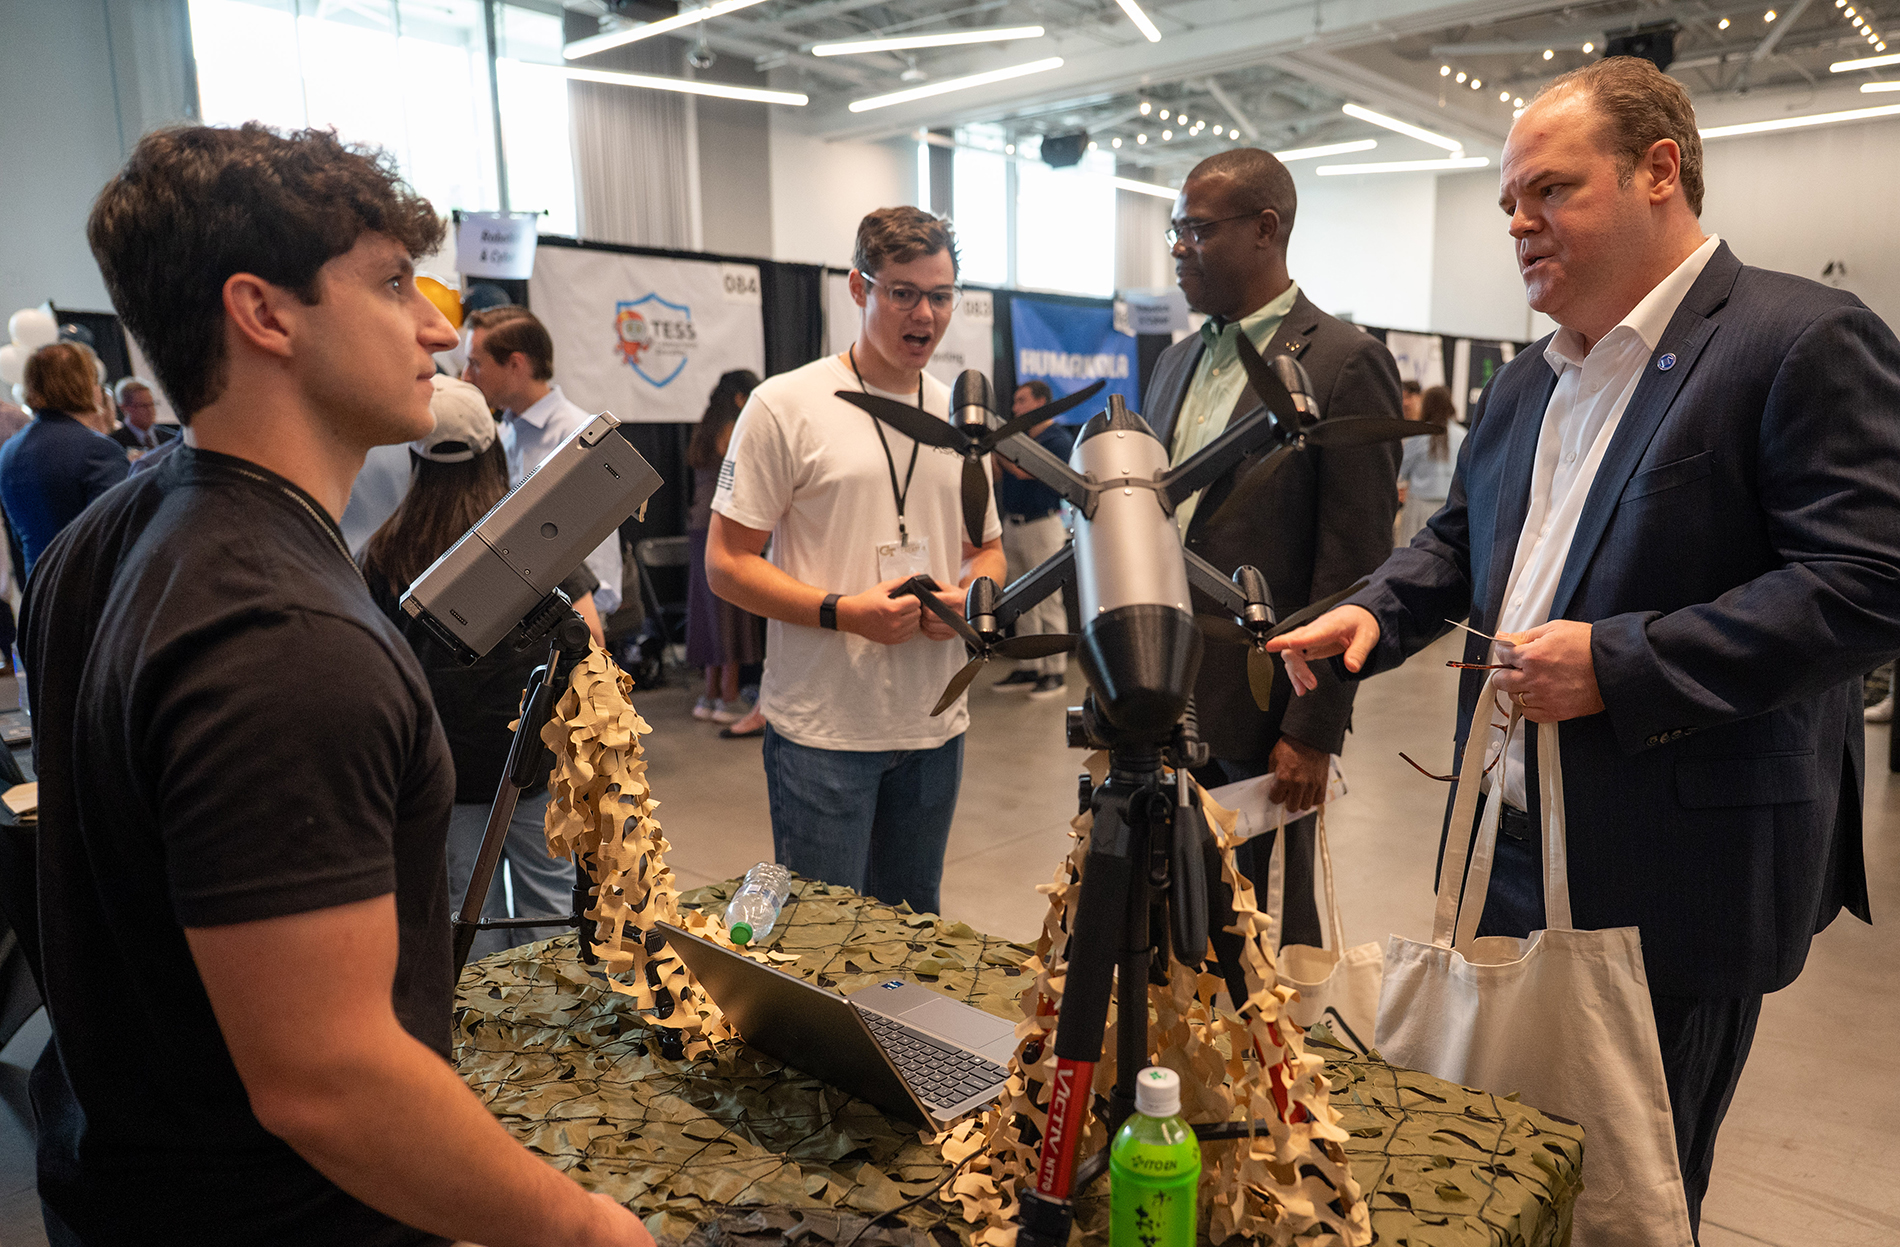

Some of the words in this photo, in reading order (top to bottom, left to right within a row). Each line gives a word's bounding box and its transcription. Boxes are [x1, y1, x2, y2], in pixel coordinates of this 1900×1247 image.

[724, 274, 758, 294] 084
[652, 320, 697, 340] TESS
[1048, 1068, 1074, 1155] VICTIV
